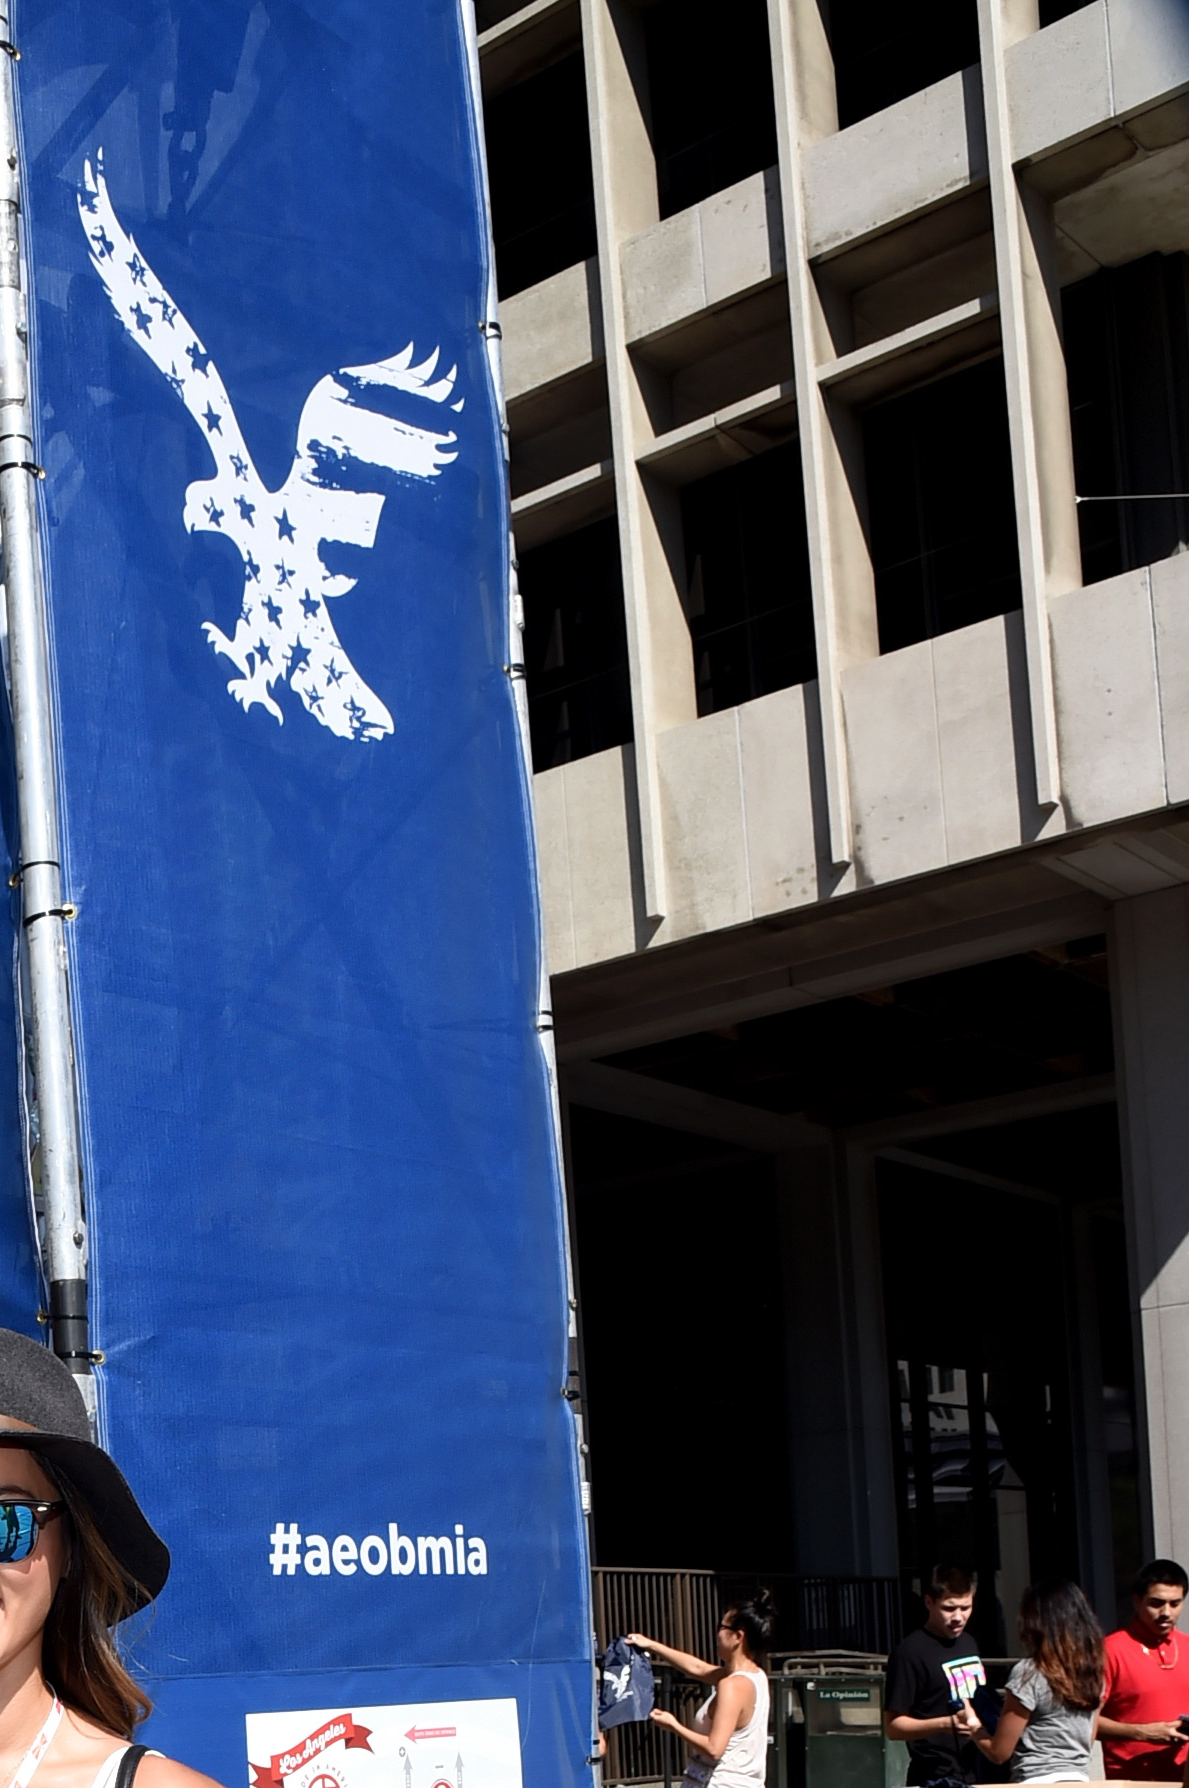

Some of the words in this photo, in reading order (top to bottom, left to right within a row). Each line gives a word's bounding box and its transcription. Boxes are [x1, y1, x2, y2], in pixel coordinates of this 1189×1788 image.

[268, 1522, 489, 1576] #aeobmia
[279, 1753, 303, 1775] Los
[302, 1722, 347, 1760] Angeles
